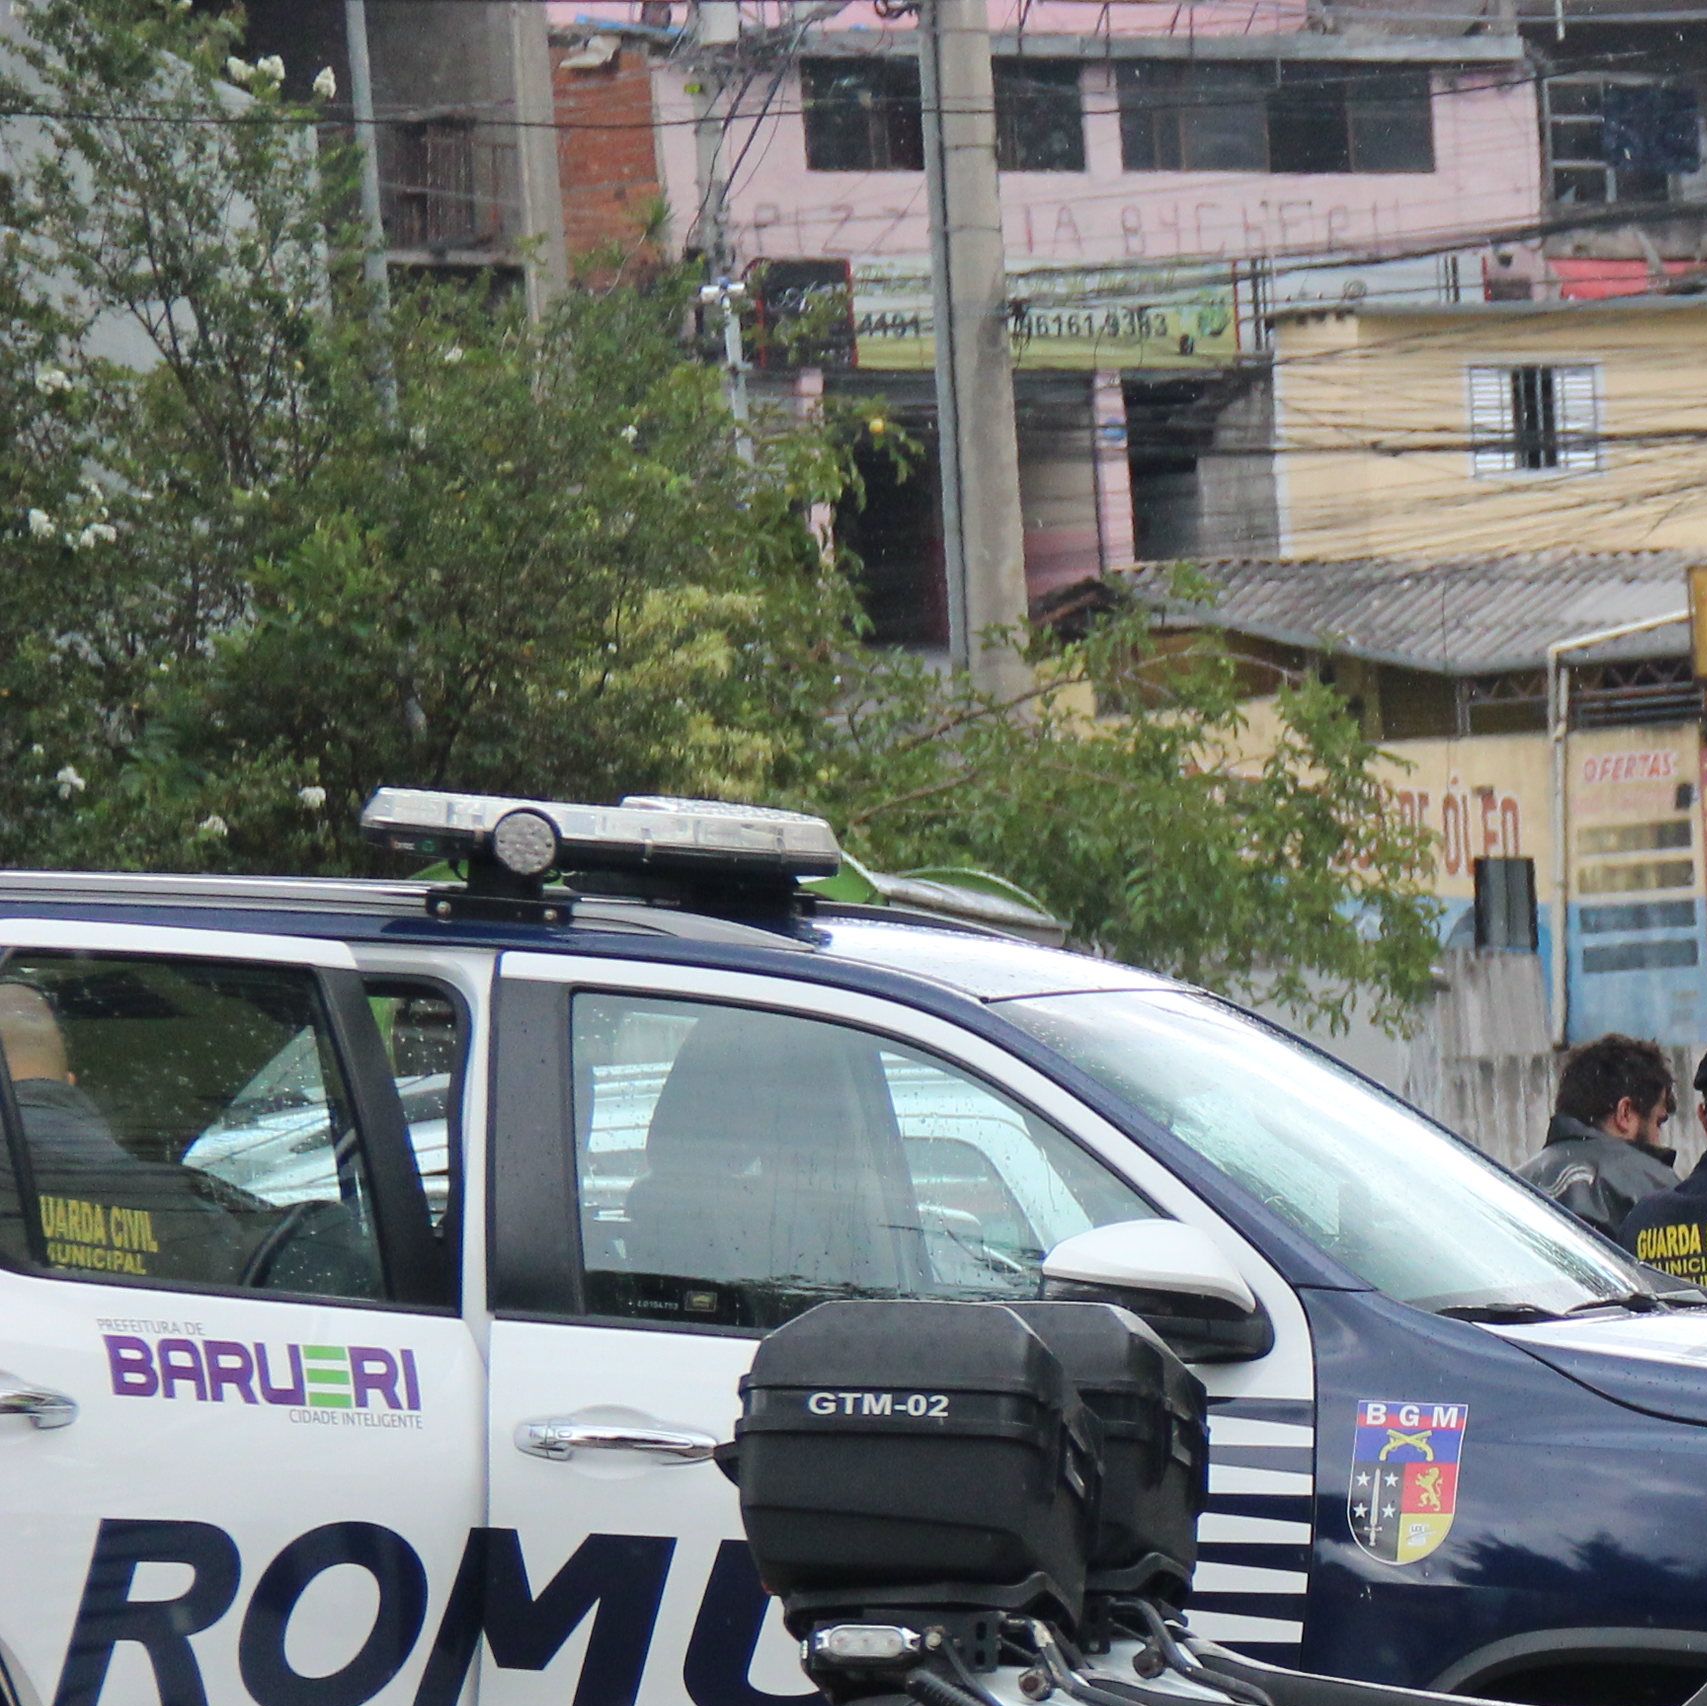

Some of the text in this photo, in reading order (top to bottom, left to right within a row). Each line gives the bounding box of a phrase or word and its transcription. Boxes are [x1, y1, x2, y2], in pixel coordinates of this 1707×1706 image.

[1582, 751, 1673, 783] OFERTAS
[110, 1205, 159, 1253] CIVIL
[1636, 1213, 1701, 1261] GUARDA
[97, 1318, 205, 1336] PREFEITURA DE
[102, 1334, 422, 1411] BARUERI
[289, 1409, 423, 1430] CIDADE INTELIGENTE
[808, 1391, 950, 1418] GTM-02
